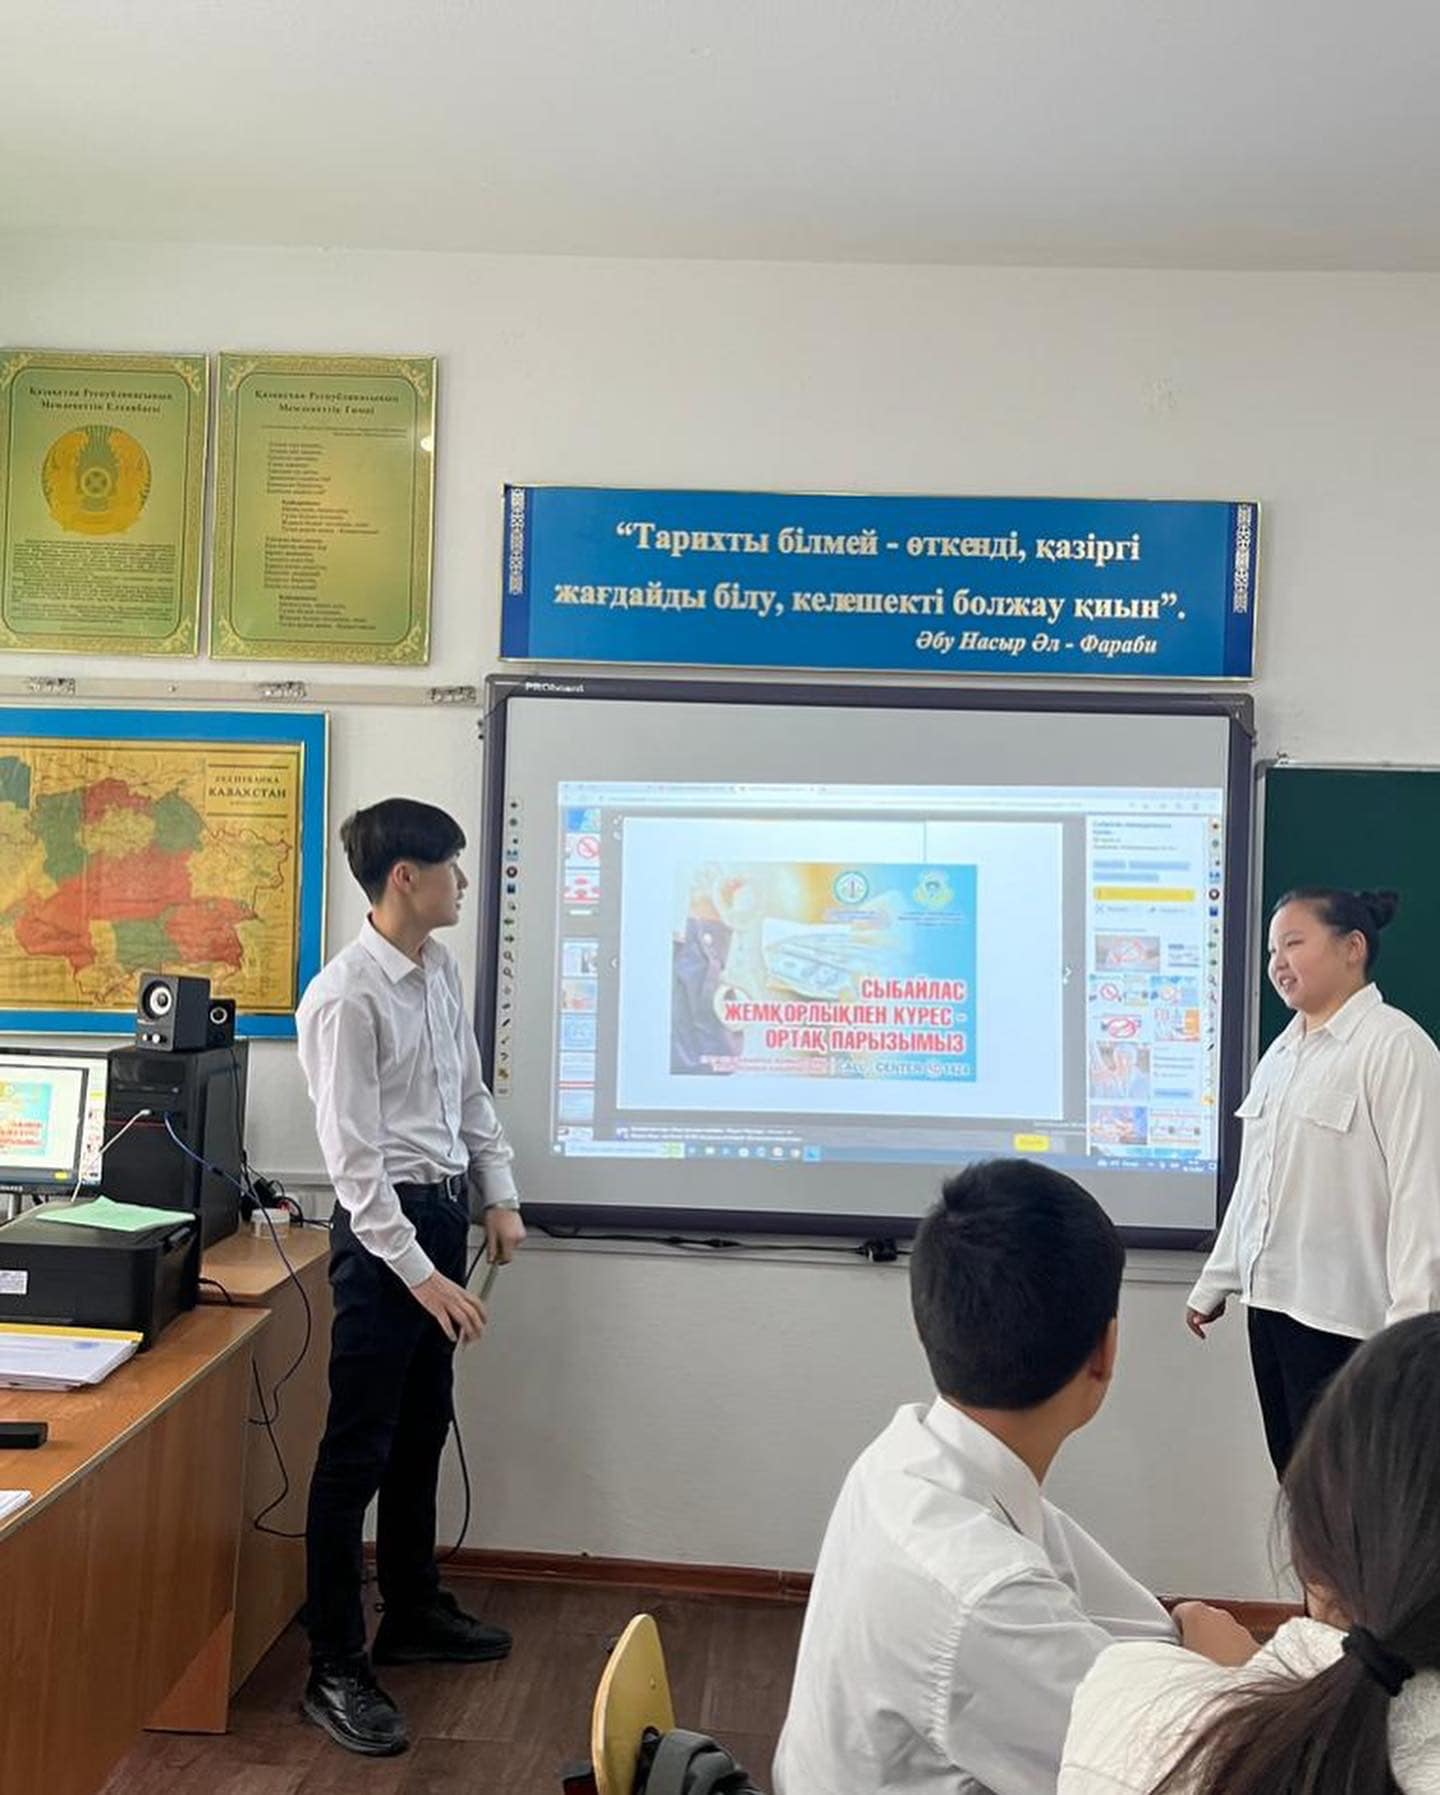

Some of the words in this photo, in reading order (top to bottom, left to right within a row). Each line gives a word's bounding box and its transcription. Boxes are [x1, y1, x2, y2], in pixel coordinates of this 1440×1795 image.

[778, 526, 879, 557] білмей
[906, 530, 1027, 563] өткенді,
[1036, 533, 1141, 568] қазіргі
[553, 581, 707, 612] жағдайды
[713, 582, 784, 617] білу,
[792, 588, 945, 615] келешекті
[953, 588, 1065, 624] болжау
[916, 631, 955, 654] Әбу
[958, 631, 1026, 656] Насыр
[1031, 632, 1061, 652] Әл
[1080, 634, 1158, 657] Фараби
[208, 787, 287, 799] КАЗАХСТАН
[861, 977, 966, 1001] СЫБАЙЛАС
[724, 1003, 888, 1026] ЖЕМҚОРЛЫҚПЕН
[766, 1029, 826, 1052] ОРТАҚ
[831, 1029, 966, 1053] ПАРЫЗЫМЫЗ
